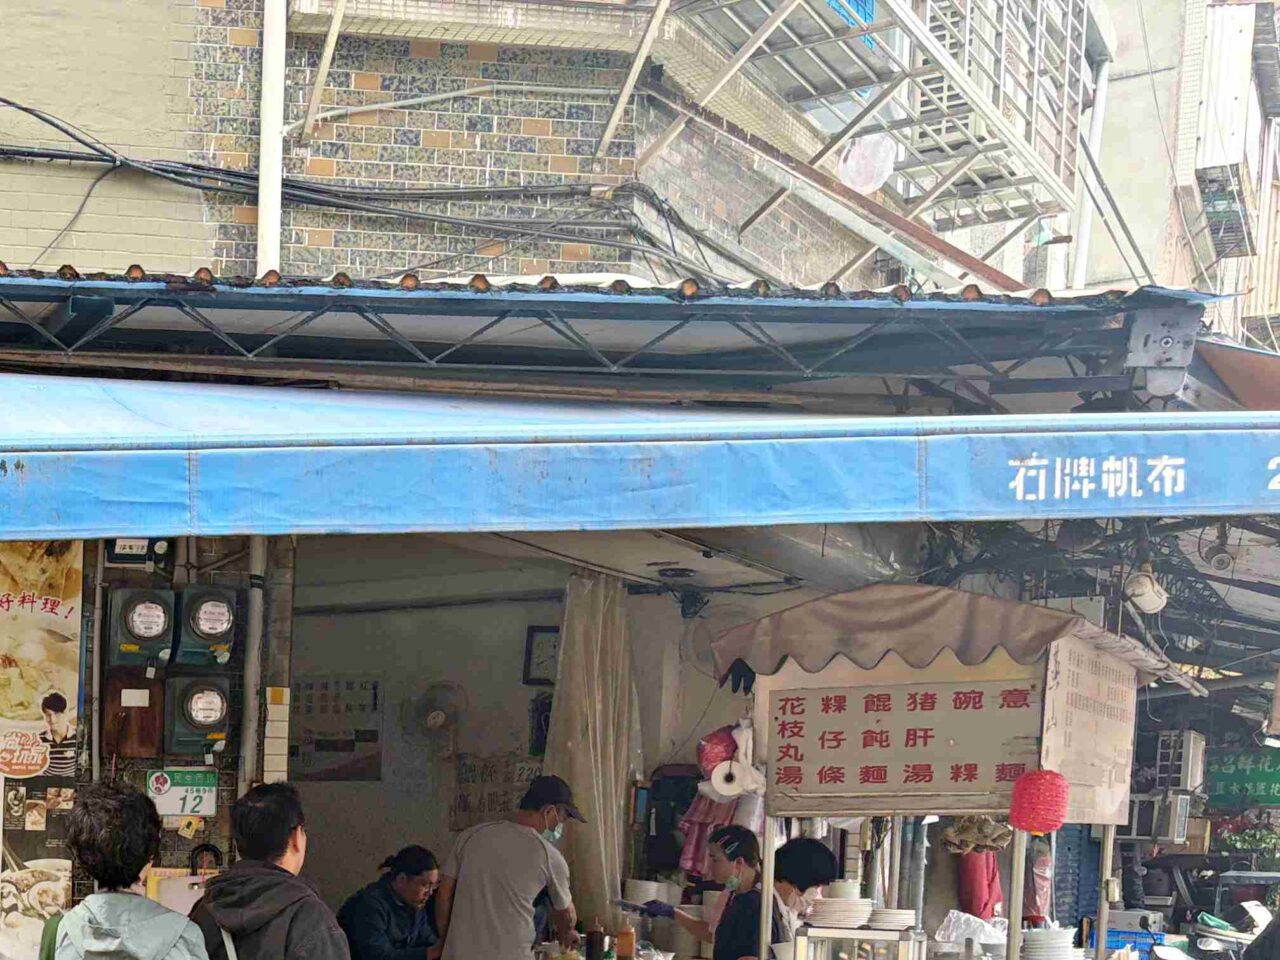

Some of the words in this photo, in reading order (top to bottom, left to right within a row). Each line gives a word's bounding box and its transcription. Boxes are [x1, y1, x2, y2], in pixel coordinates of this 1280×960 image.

[1007, 451, 1187, 501] 石牌帆布
[775, 696, 807, 786] 花枝丸湯
[816, 694, 848, 785] 粿仔條
[858, 692, 892, 785] 餛飩麵
[950, 689, 984, 783] 碗粿
[179, 794, 204, 814] 12
